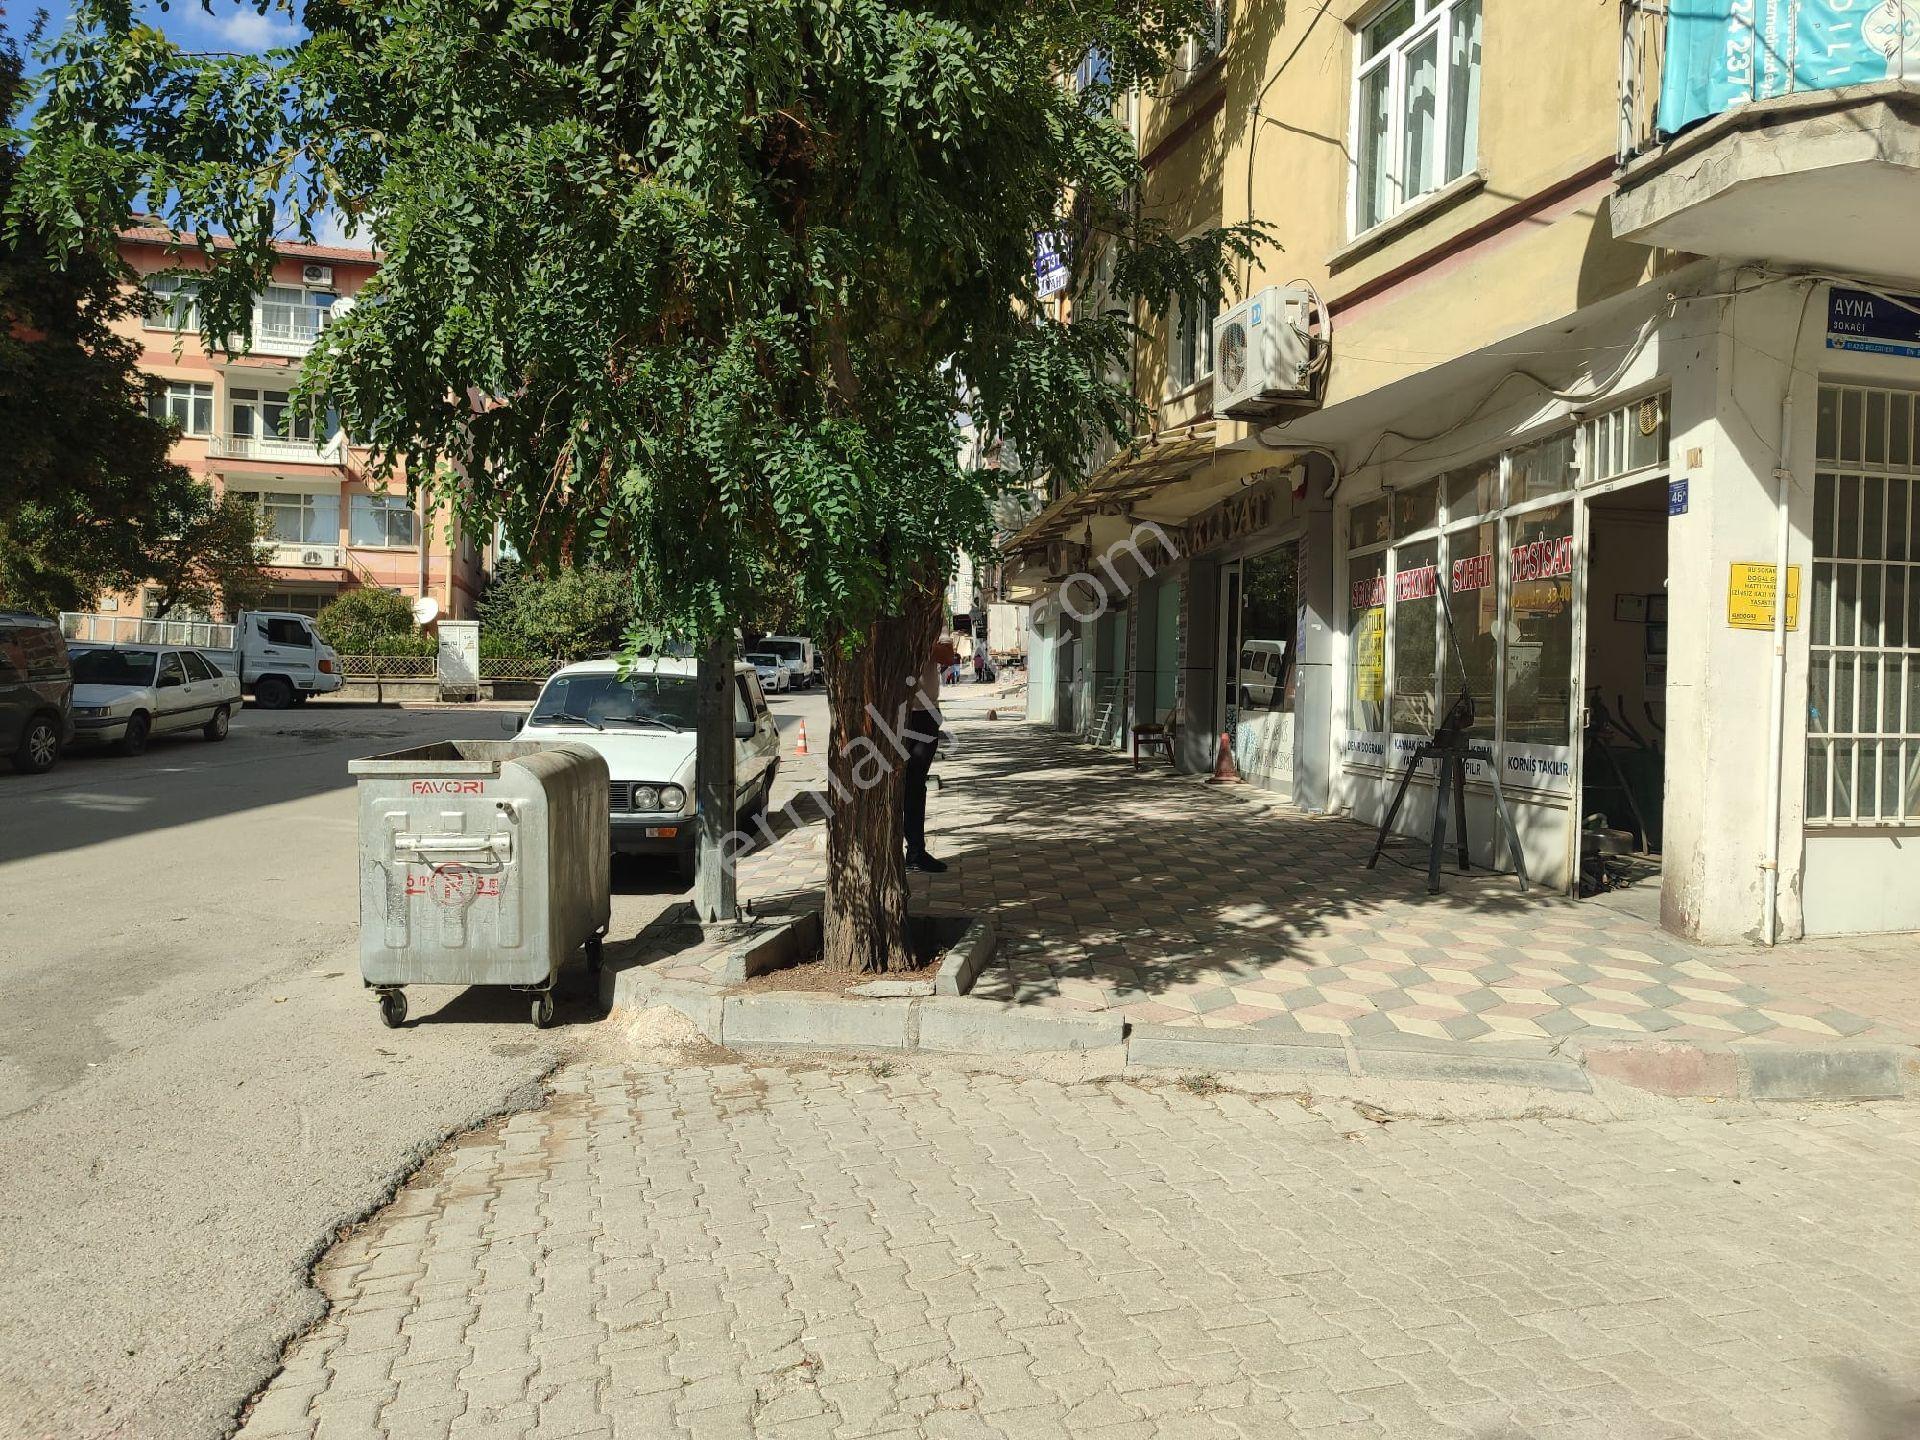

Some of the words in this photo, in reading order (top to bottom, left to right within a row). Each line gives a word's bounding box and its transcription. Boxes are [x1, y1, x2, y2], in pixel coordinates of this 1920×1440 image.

[1834, 297, 1874, 318] AYNA
[1833, 320, 1866, 332] SOKAĞI
[1510, 530, 1574, 583] TESİSAT
[1507, 755, 1537, 776] KORNİŞ
[1537, 759, 1569, 777] TAKILIR
[411, 781, 484, 795] FAVORI
